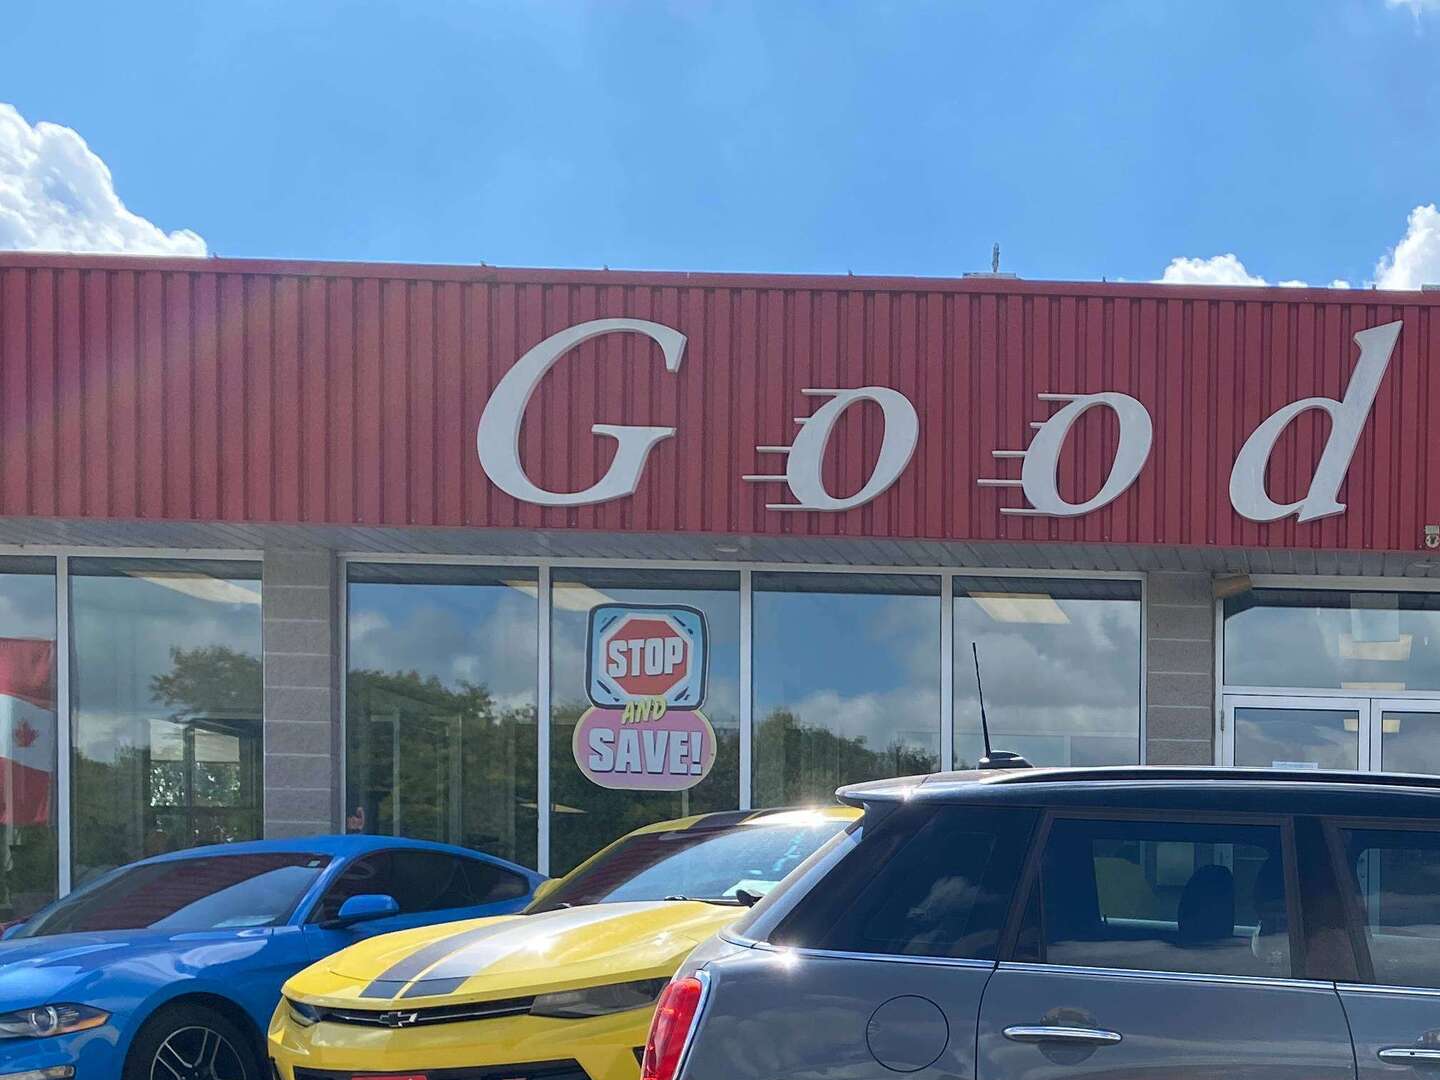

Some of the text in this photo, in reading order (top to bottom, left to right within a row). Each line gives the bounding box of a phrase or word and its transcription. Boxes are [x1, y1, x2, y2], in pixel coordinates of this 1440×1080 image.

[608, 637, 684, 678] STOP
[621, 697, 668, 725] AND
[588, 727, 704, 776] SAVE!
